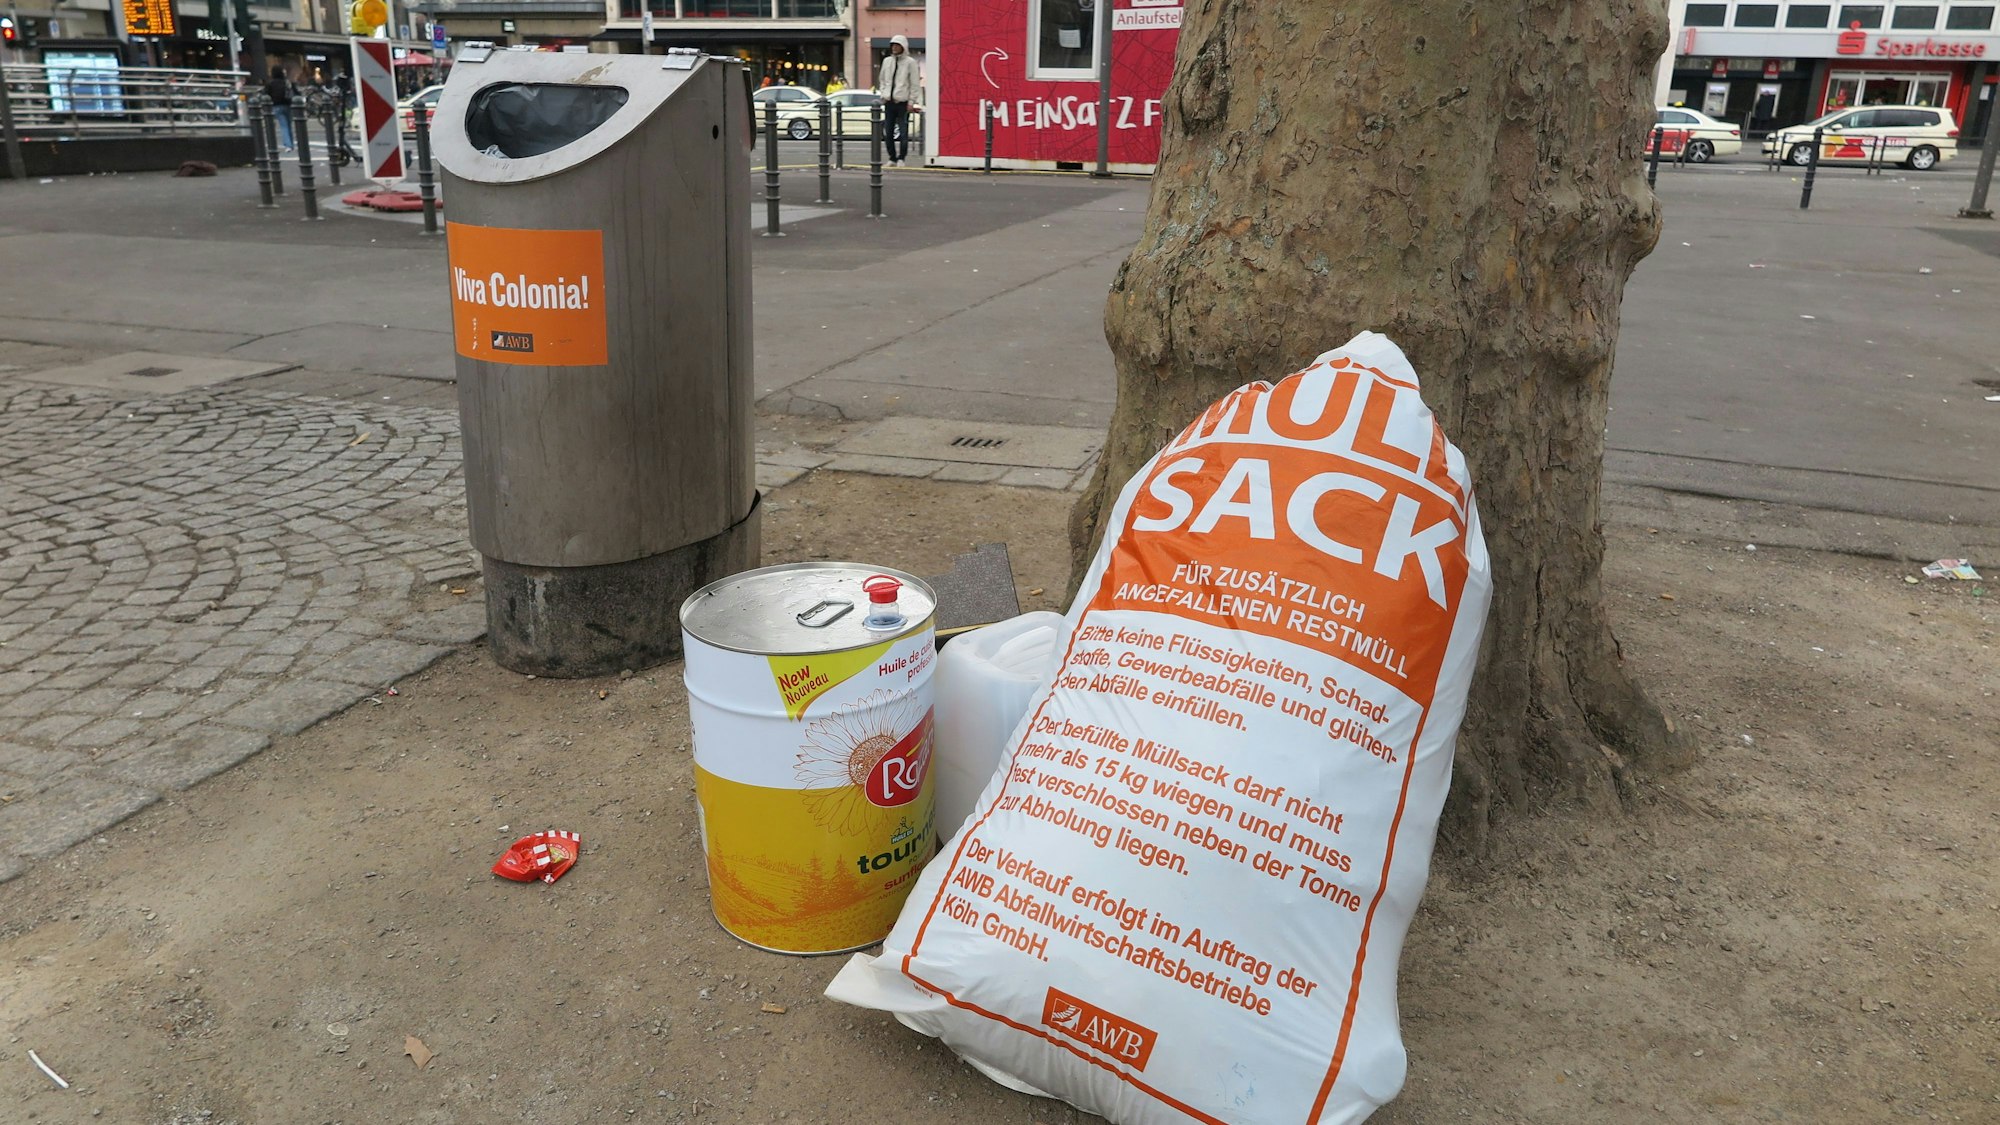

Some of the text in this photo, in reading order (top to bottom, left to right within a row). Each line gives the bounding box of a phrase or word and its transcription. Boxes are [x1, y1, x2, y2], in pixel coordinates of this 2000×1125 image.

[1875, 36, 1986, 59] Sparkasse
[454, 266, 589, 310] Viva Colonia!
[505, 336, 531, 349] AWB
[1132, 457, 1459, 612] SACK
[1171, 559, 1366, 623] FÜR ZUSÄTZLICH
[878, 657, 907, 677] Huile
[909, 650, 920, 664] de
[1113, 582, 1410, 680] ANGEFALLENEN RESTMÜLL
[777, 664, 811, 692] New
[784, 672, 830, 707] Nouveau
[1060, 672, 1248, 732] den Abfälle einfüllen.
[1070, 648, 1397, 763] stoffe, Gewerbeabfälle und glühen-
[1078, 625, 1390, 724] Bitte keine Flüssigkeiten, Schad-
[1022, 742, 1352, 873] mehr als 15 kg wiegen und muss
[1036, 716, 1343, 834] Der befüllte Müllsack darf nicht
[999, 794, 1189, 877] zur Abholung liegen.
[1012, 763, 1362, 913] fest verschlossen neben der Tonne
[941, 892, 1050, 963] Köln GmbH.
[952, 866, 1272, 1017] AWB Abfallwirtschaftsbetriebe
[965, 837, 995, 864] Der
[996, 848, 1072, 897] Verkauf
[1071, 886, 1148, 932] erfolgt
[1149, 912, 1180, 944] im
[1182, 927, 1274, 987] Auftrag
[1276, 968, 1318, 998] der
[1080, 1016, 1144, 1060] AWB
